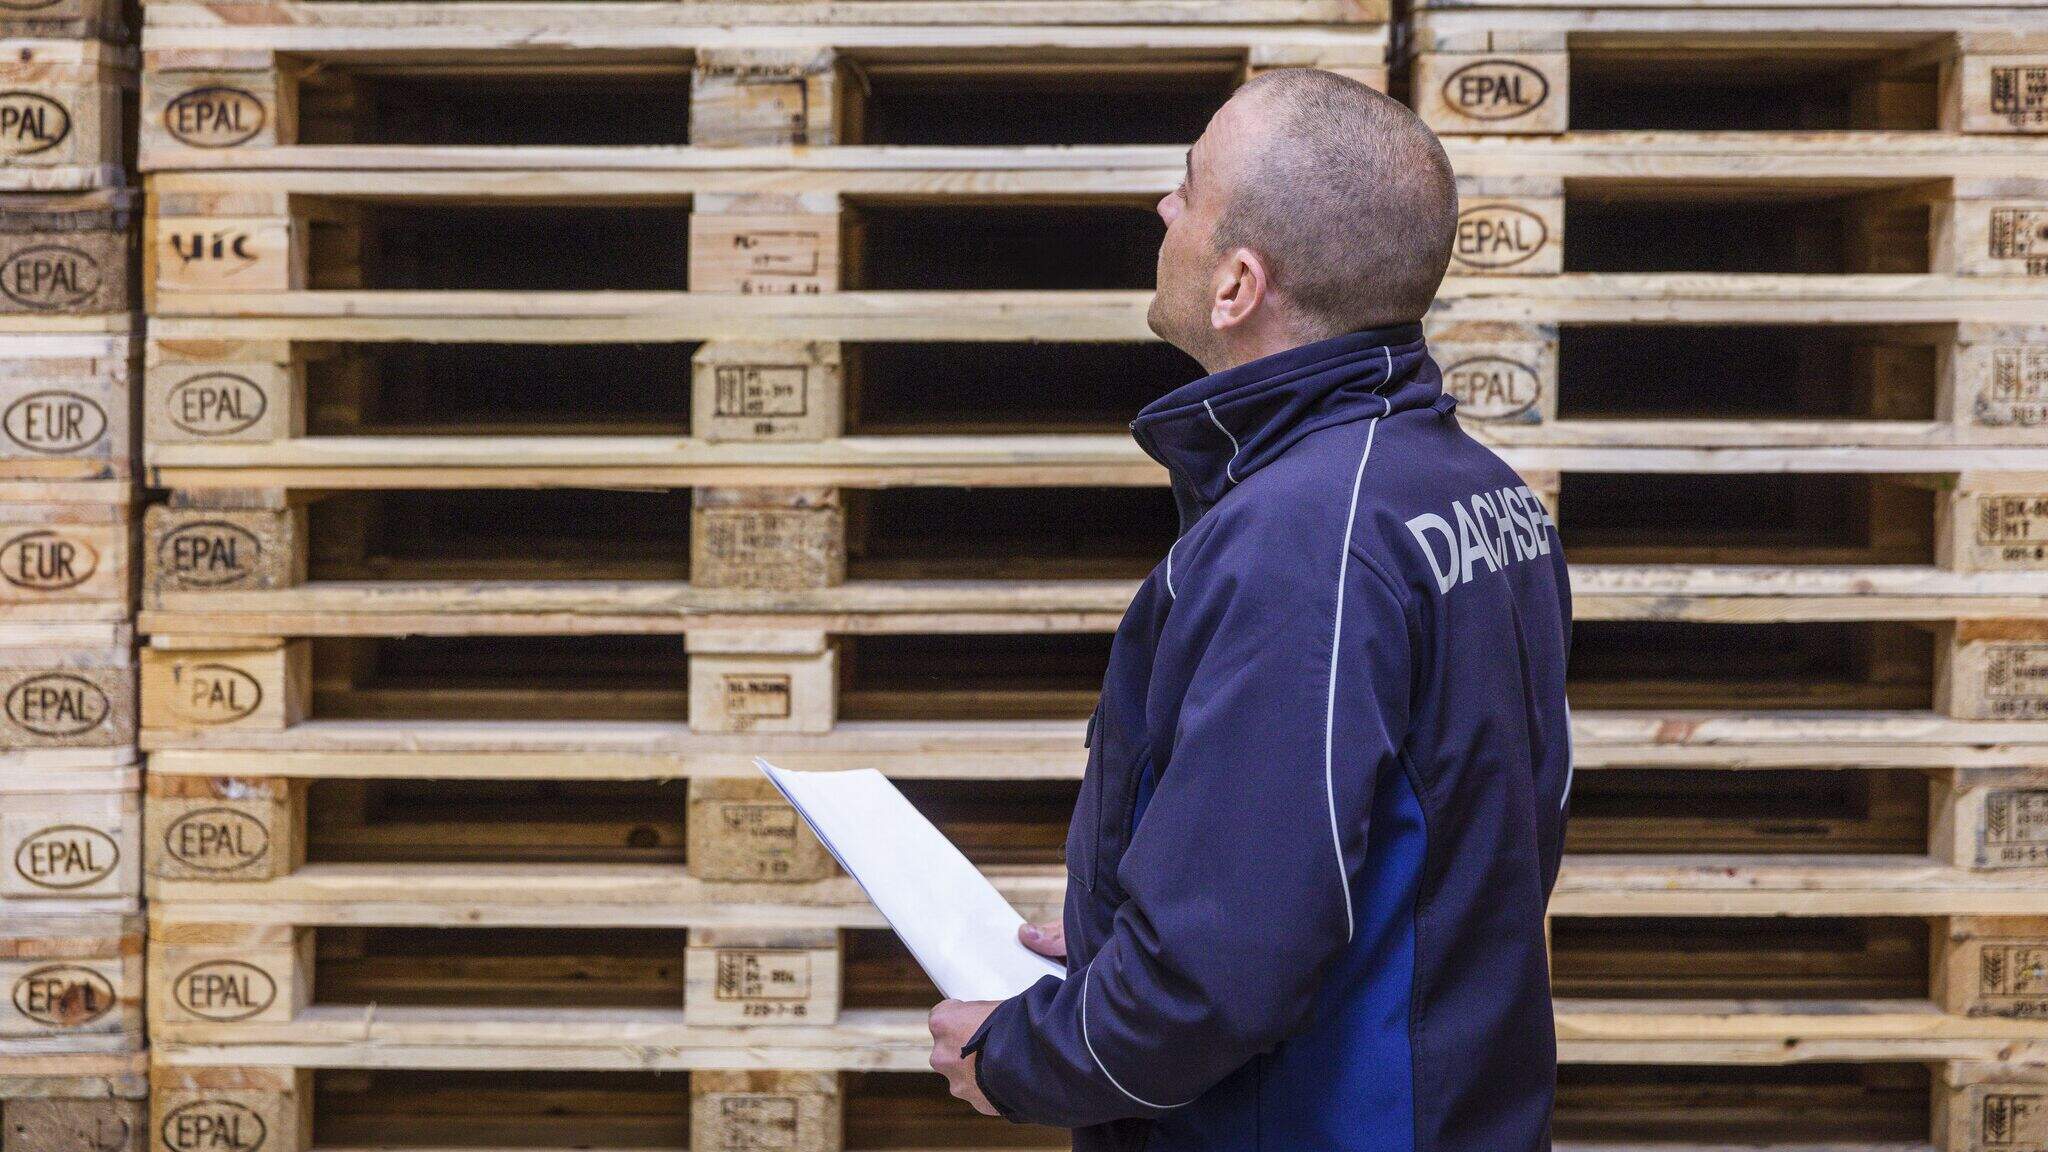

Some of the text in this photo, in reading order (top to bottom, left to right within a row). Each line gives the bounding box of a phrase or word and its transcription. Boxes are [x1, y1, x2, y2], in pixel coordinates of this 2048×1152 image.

[1459, 75, 1531, 107] EPAL
[0, 104, 54, 143] PAL
[178, 98, 248, 133] EPAL
[1458, 219, 1529, 253] EPAL
[16, 258, 89, 294] EPAL
[25, 402, 84, 441] EUR
[182, 387, 256, 422] EPAL
[19, 541, 75, 580] EUR
[174, 536, 246, 571] EPAL
[22, 687, 91, 721] EPAL
[29, 839, 102, 876] EPAL
[180, 822, 252, 858] EPAL
[188, 974, 258, 1008] EPAL
[174, 1114, 247, 1149] EPAL
